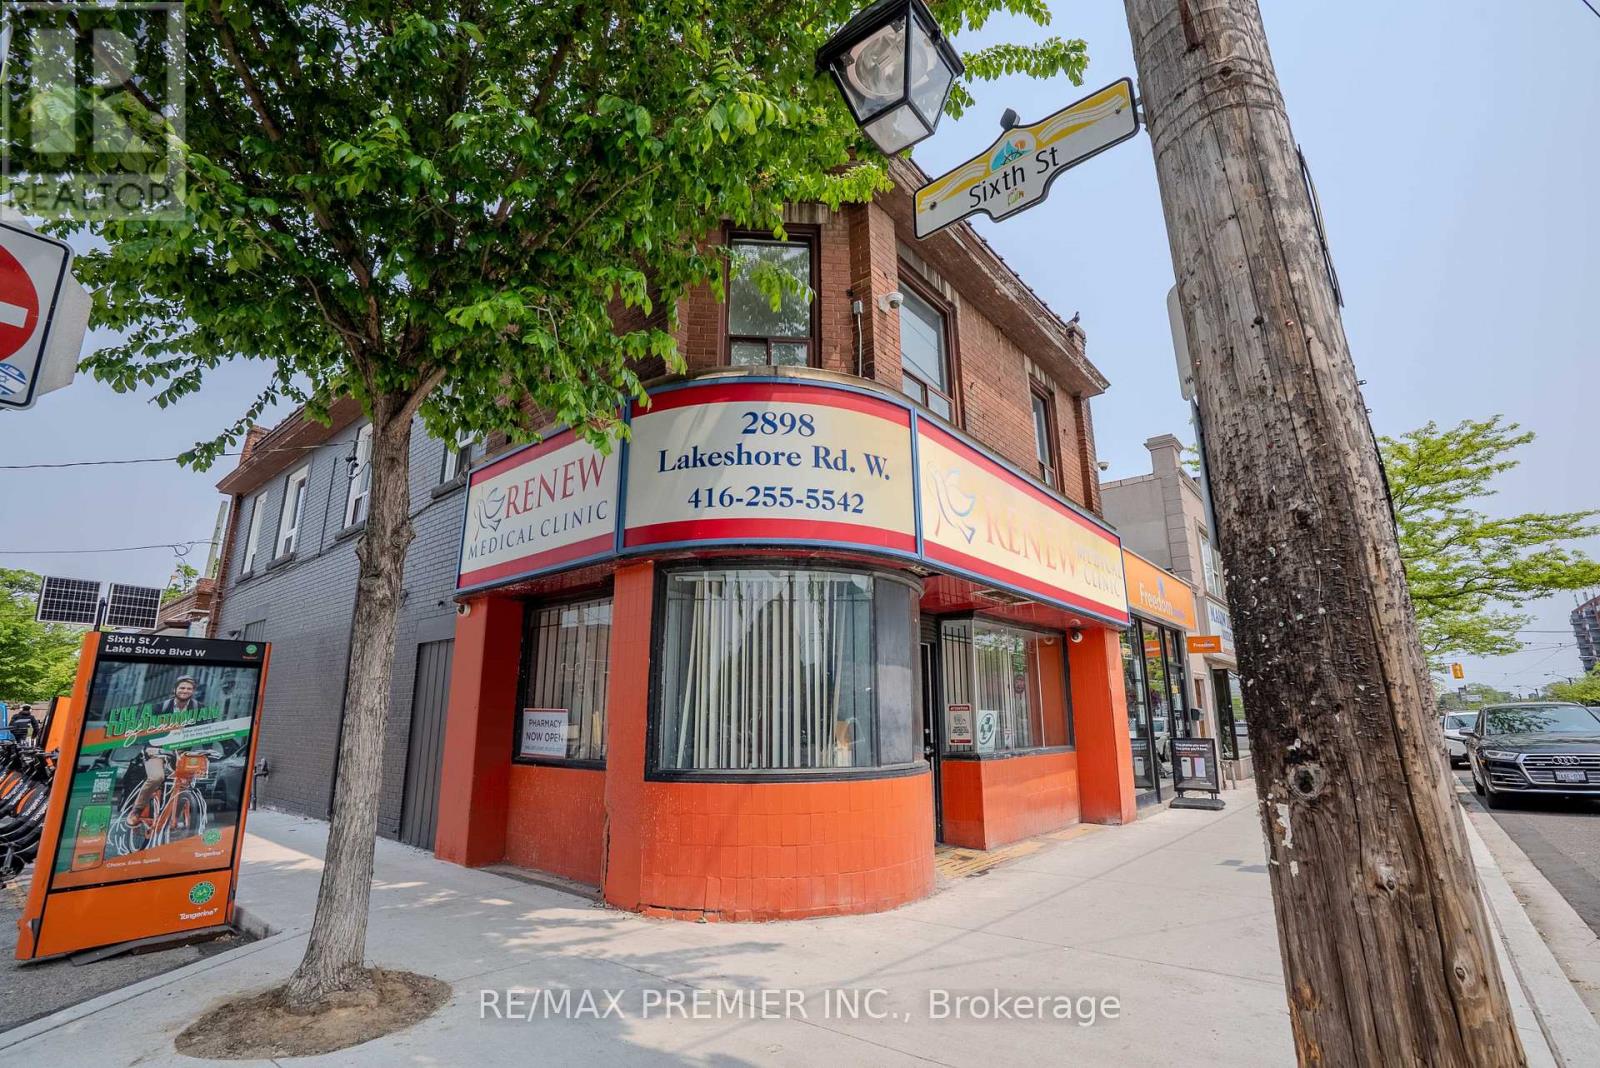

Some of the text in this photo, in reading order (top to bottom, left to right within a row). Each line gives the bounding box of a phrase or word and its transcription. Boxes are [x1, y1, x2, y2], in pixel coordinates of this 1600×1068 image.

[969, 165, 1025, 209] Sixth
[1036, 146, 1059, 174] St
[741, 411, 816, 437] 2898
[658, 443, 890, 480] Lakeshore Rd. W.
[505, 453, 606, 519] RENEW
[688, 486, 865, 514] 416-255-5542
[467, 500, 608, 560] MEDICAL CLINIC
[985, 498, 1078, 577] RENEW
[1139, 582, 1172, 616] Freedom
[105, 645, 206, 657] Lake Shore Blvd W
[107, 635, 136, 644] Sixth
[138, 636, 151, 645] St
[526, 731, 564, 742] NOW OPEN
[528, 719, 562, 728] PHARMACY
[180, 909, 216, 920] Tangerine
